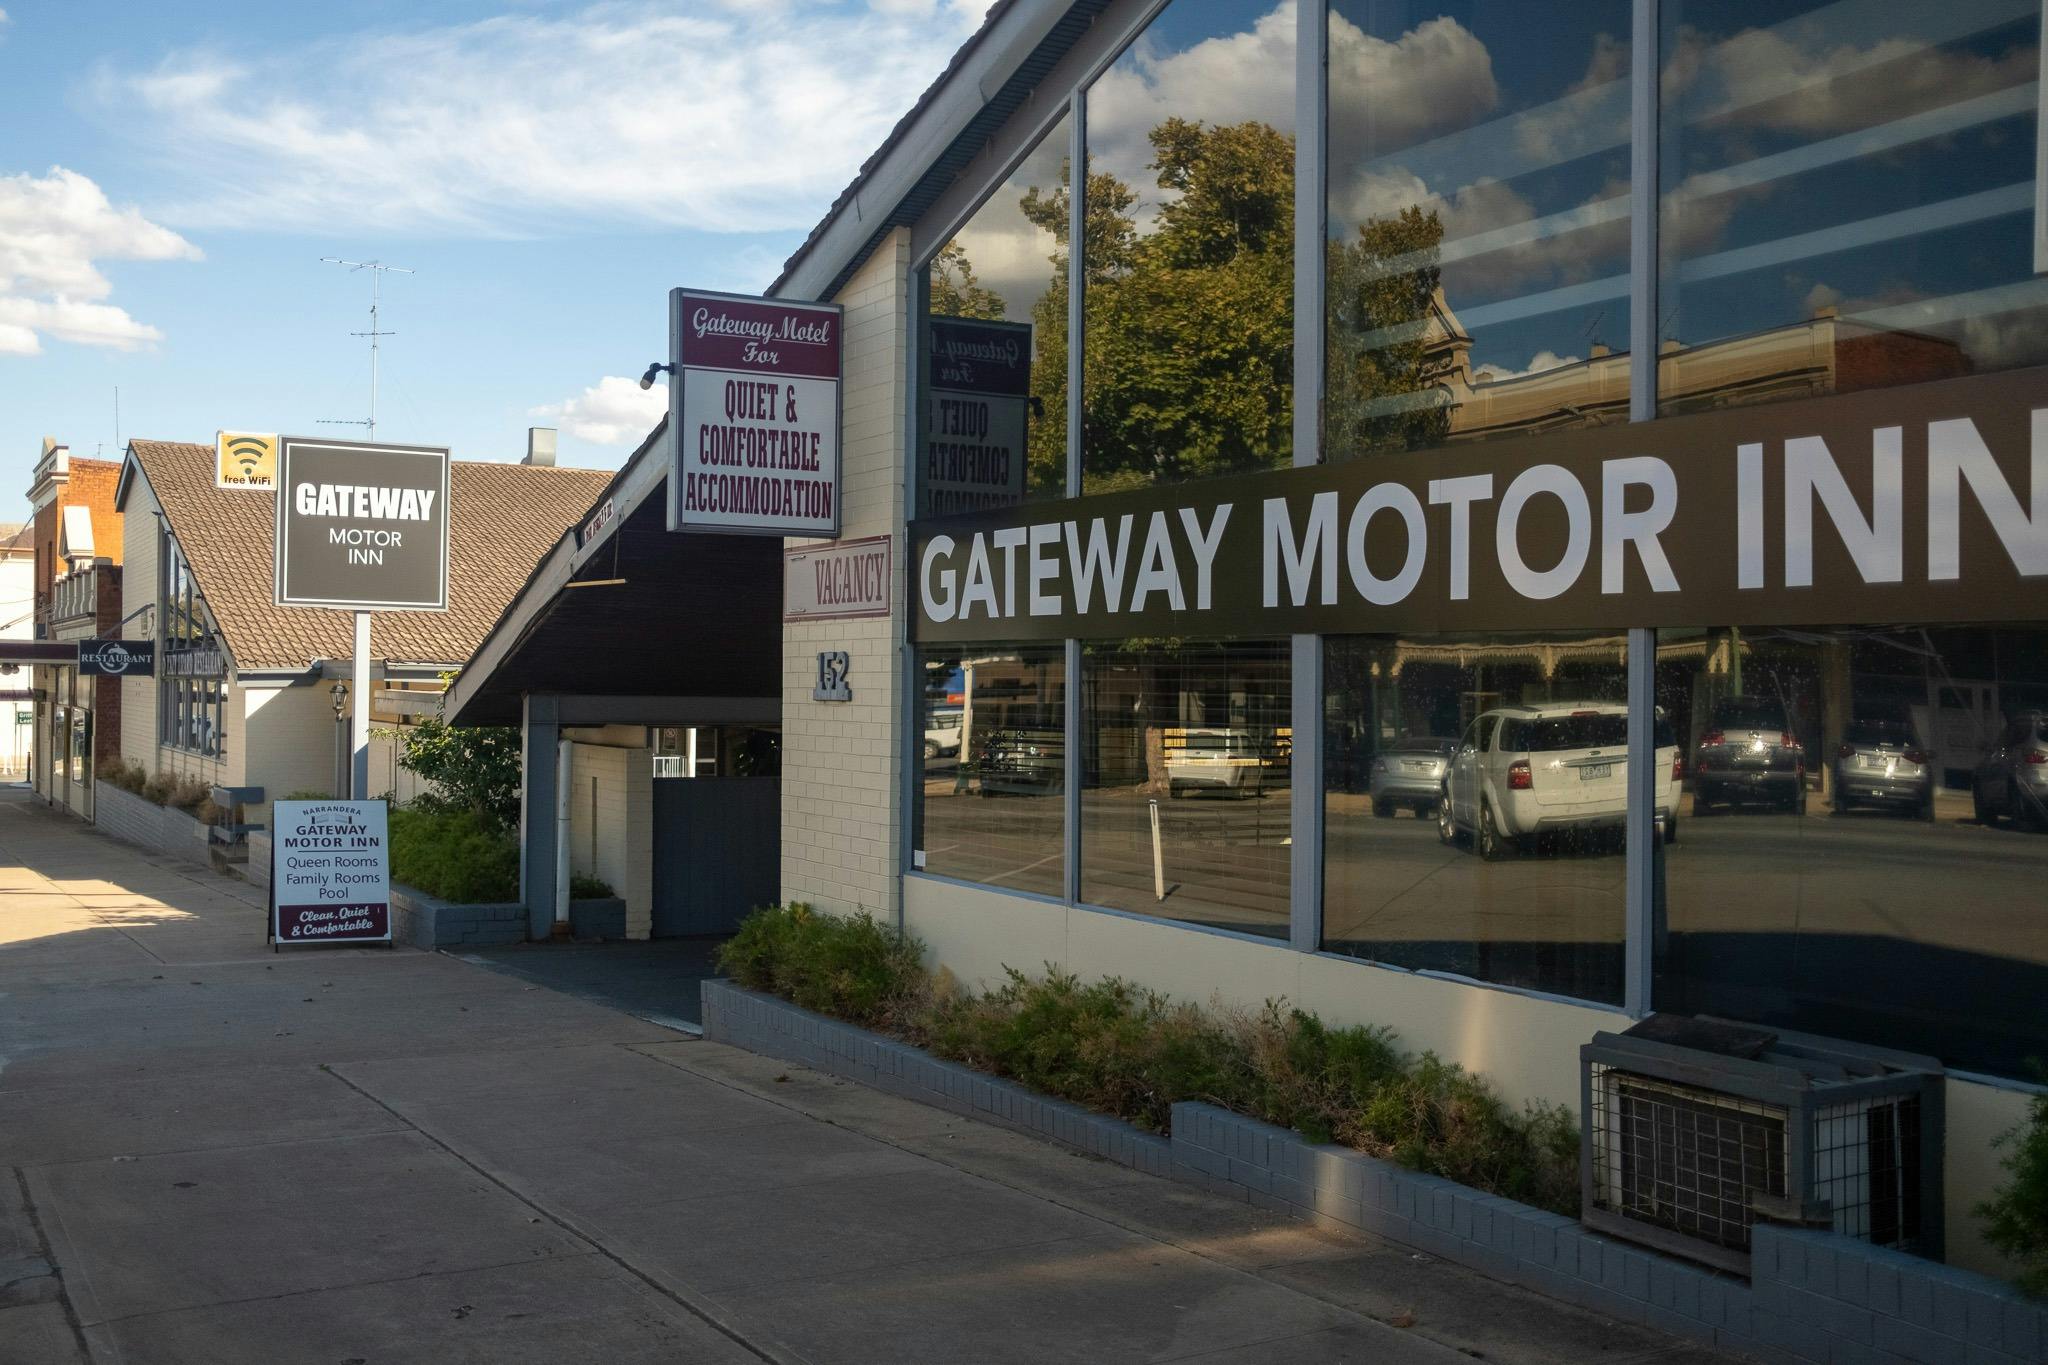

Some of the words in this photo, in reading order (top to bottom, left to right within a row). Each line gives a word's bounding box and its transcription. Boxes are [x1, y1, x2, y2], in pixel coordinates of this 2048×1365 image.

[692, 306, 775, 345] Gateway
[775, 316, 830, 344] Motel
[742, 341, 780, 365] For
[724, 379, 779, 423] QUIET
[785, 385, 798, 423] &
[699, 423, 820, 472] COMFORTABLE
[224, 474, 246, 485] free
[248, 475, 271, 486] WiFi
[295, 482, 436, 521] GATEWAY
[685, 472, 833, 520] ACCOMMODATION
[920, 503, 1233, 623] GATEWAY
[1263, 456, 1681, 607] MOTOR
[1737, 408, 2048, 590] INN
[329, 528, 402, 547] MOTOR
[348, 549, 383, 566] INN
[814, 553, 884, 605] VACANCY
[81, 654, 153, 664] RESTAURANT
[816, 650, 850, 691] 152
[302, 806, 361, 816] NARRANDERA
[296, 825, 368, 836] GATEWAY
[285, 837, 343, 848] MOTOR
[350, 837, 380, 847] INN
[287, 857, 331, 869] Queen
[335, 857, 379, 868] Rooms
[286, 873, 329, 886] Family
[335, 873, 380, 884] Rooms
[319, 887, 349, 899] Pool
[339, 906, 370, 919] Quiet
[291, 926, 301, 936] &
[303, 919, 374, 936] Comfortable
